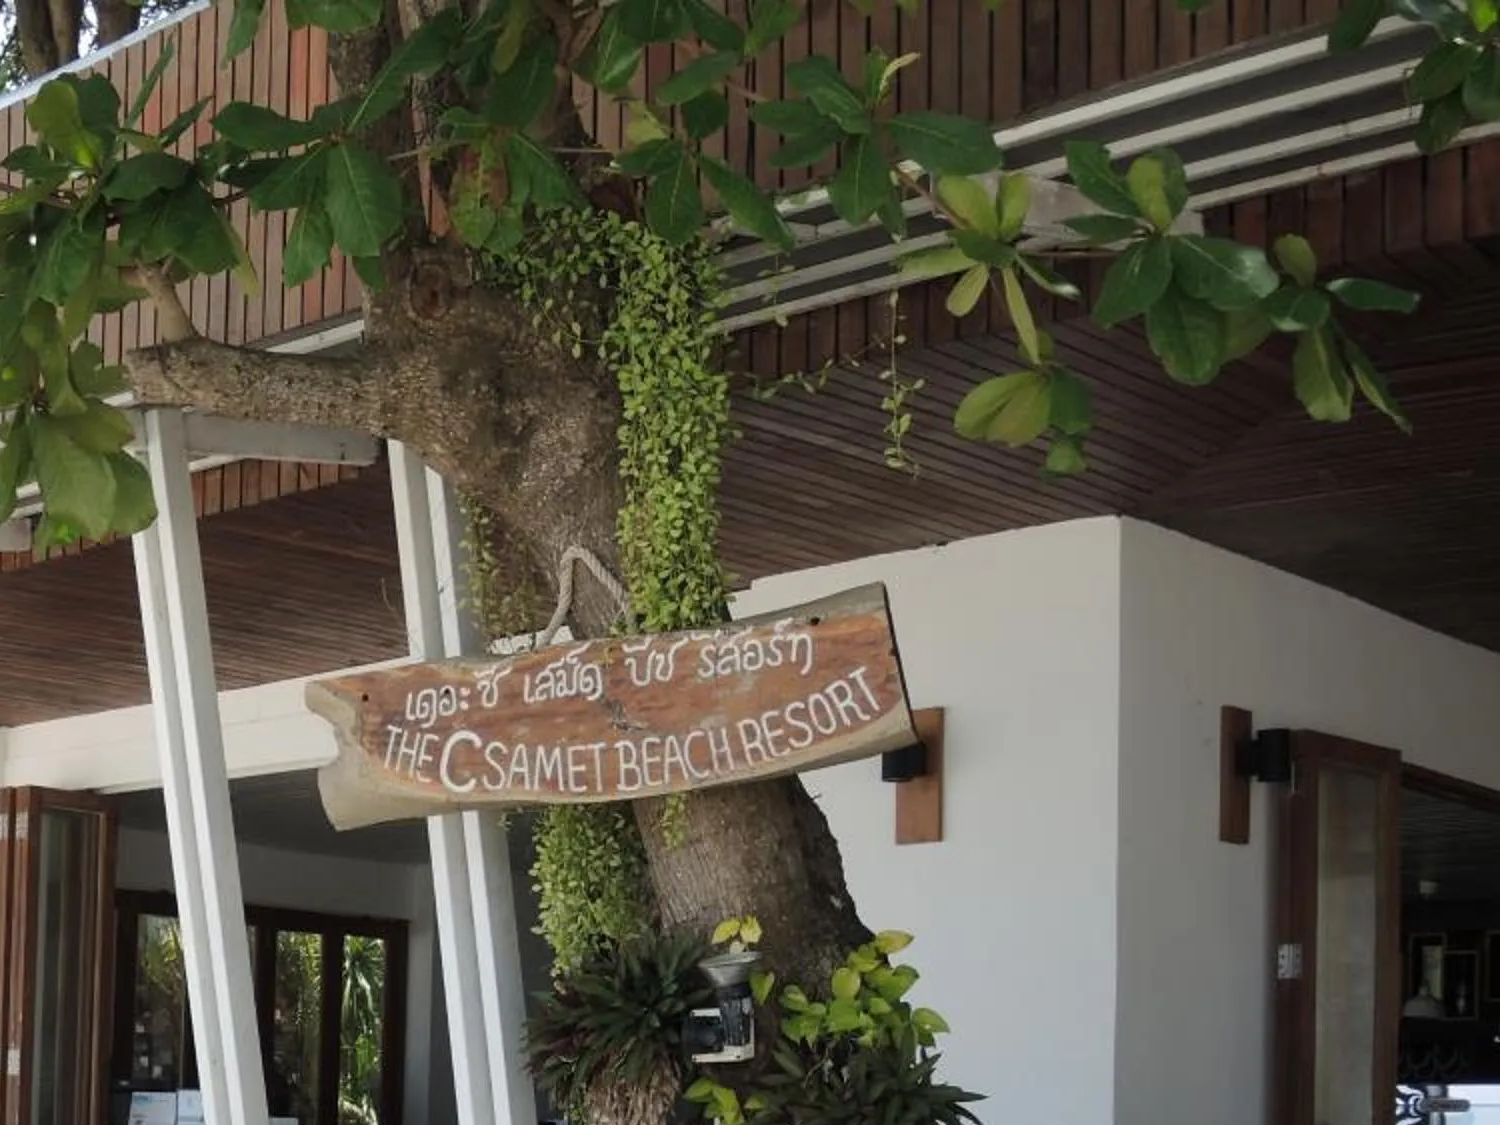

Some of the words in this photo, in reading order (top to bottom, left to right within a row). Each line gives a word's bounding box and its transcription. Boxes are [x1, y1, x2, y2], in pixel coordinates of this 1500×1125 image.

[385, 726, 439, 783] THE
[440, 730, 483, 794] C
[484, 742, 607, 794] SAMET
[615, 728, 737, 791] BEACH
[737, 666, 881, 768] RESORT
